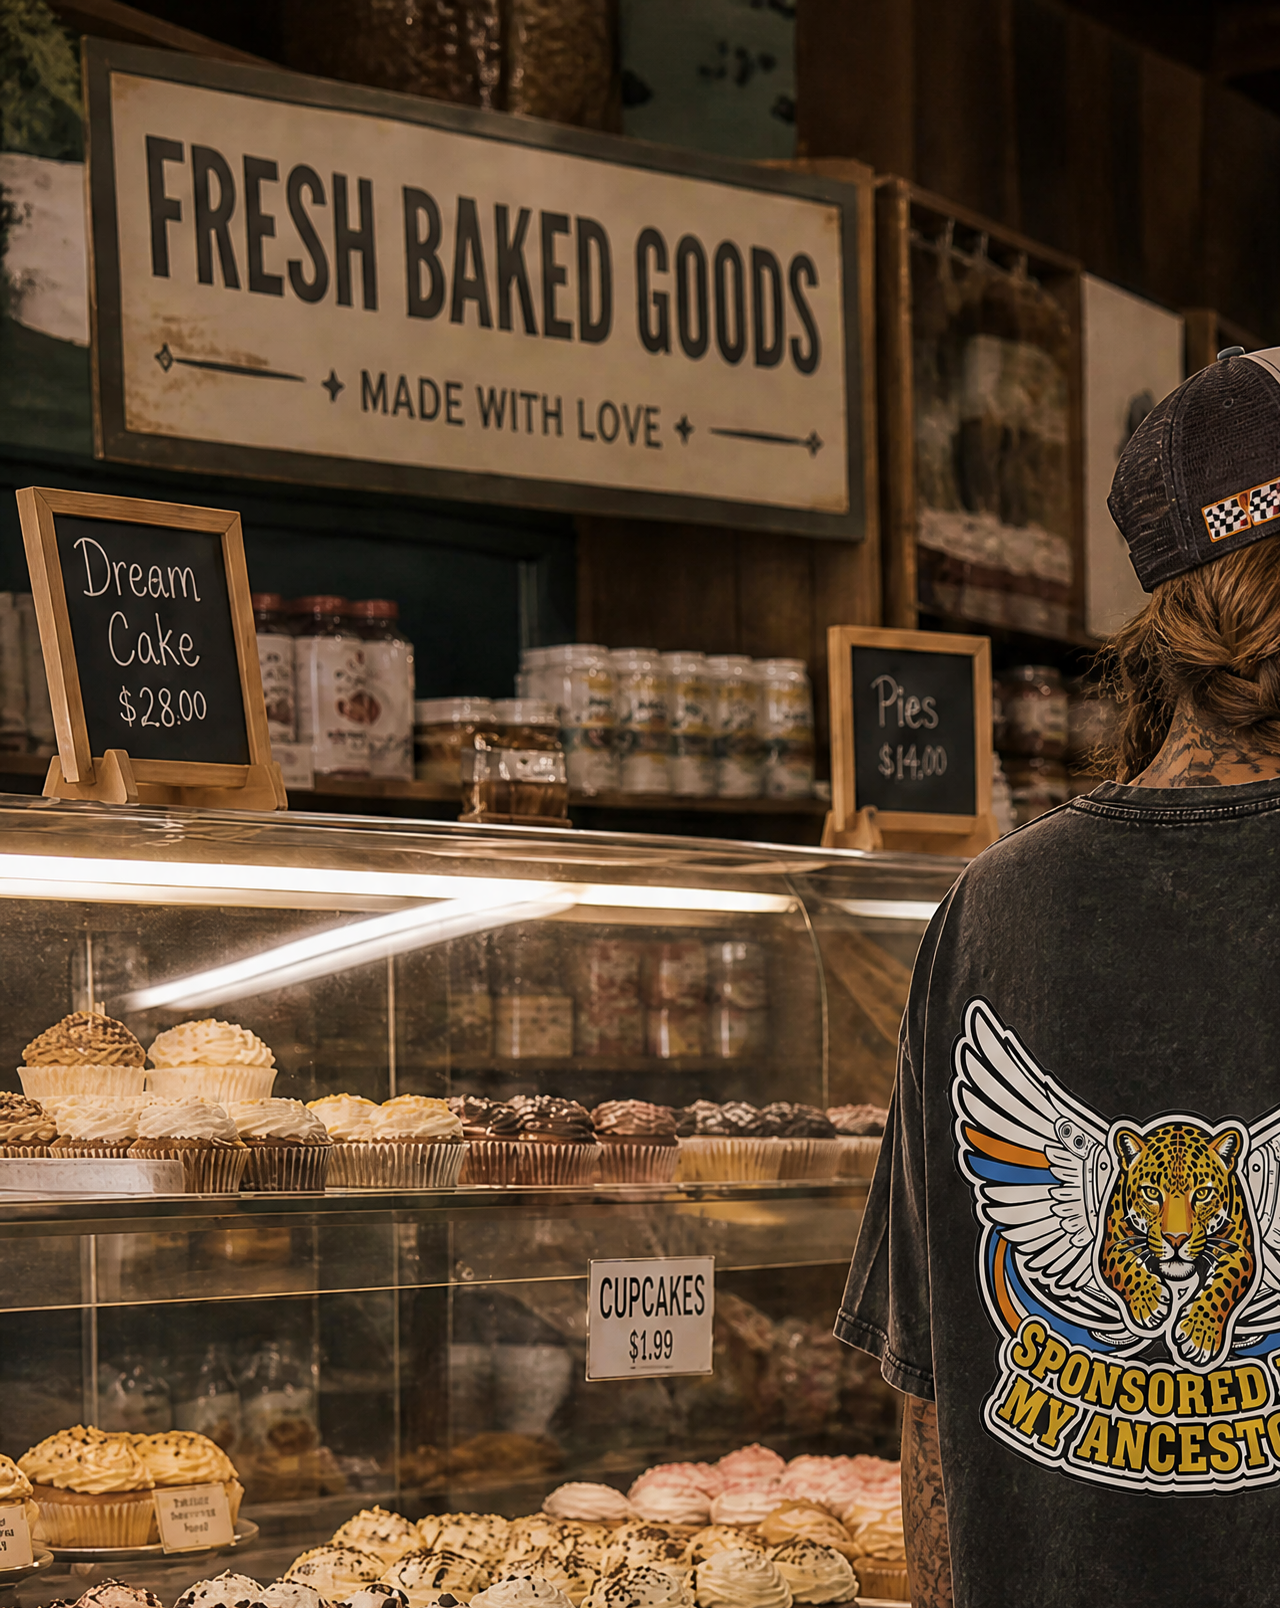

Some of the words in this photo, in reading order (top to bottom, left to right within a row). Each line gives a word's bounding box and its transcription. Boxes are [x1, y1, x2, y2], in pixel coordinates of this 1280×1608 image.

[145, 135, 379, 311] FRESH
[402, 185, 612, 345] BAKED
[635, 226, 822, 376] GOODS
[360, 370, 465, 427] MADE
[476, 385, 564, 438] WITH
[576, 398, 663, 449] LOVE
[73, 537, 201, 602] Dream
[108, 611, 201, 667] Cake
[870, 674, 939, 729] Pies
[878, 742, 947, 780] $14.00
[599, 1274, 706, 1319] CUPCAKES
[628, 1329, 674, 1365] $1.99
[1012, 1321, 1269, 1417] SPONSORED
[997, 1376, 1076, 1447] MY
